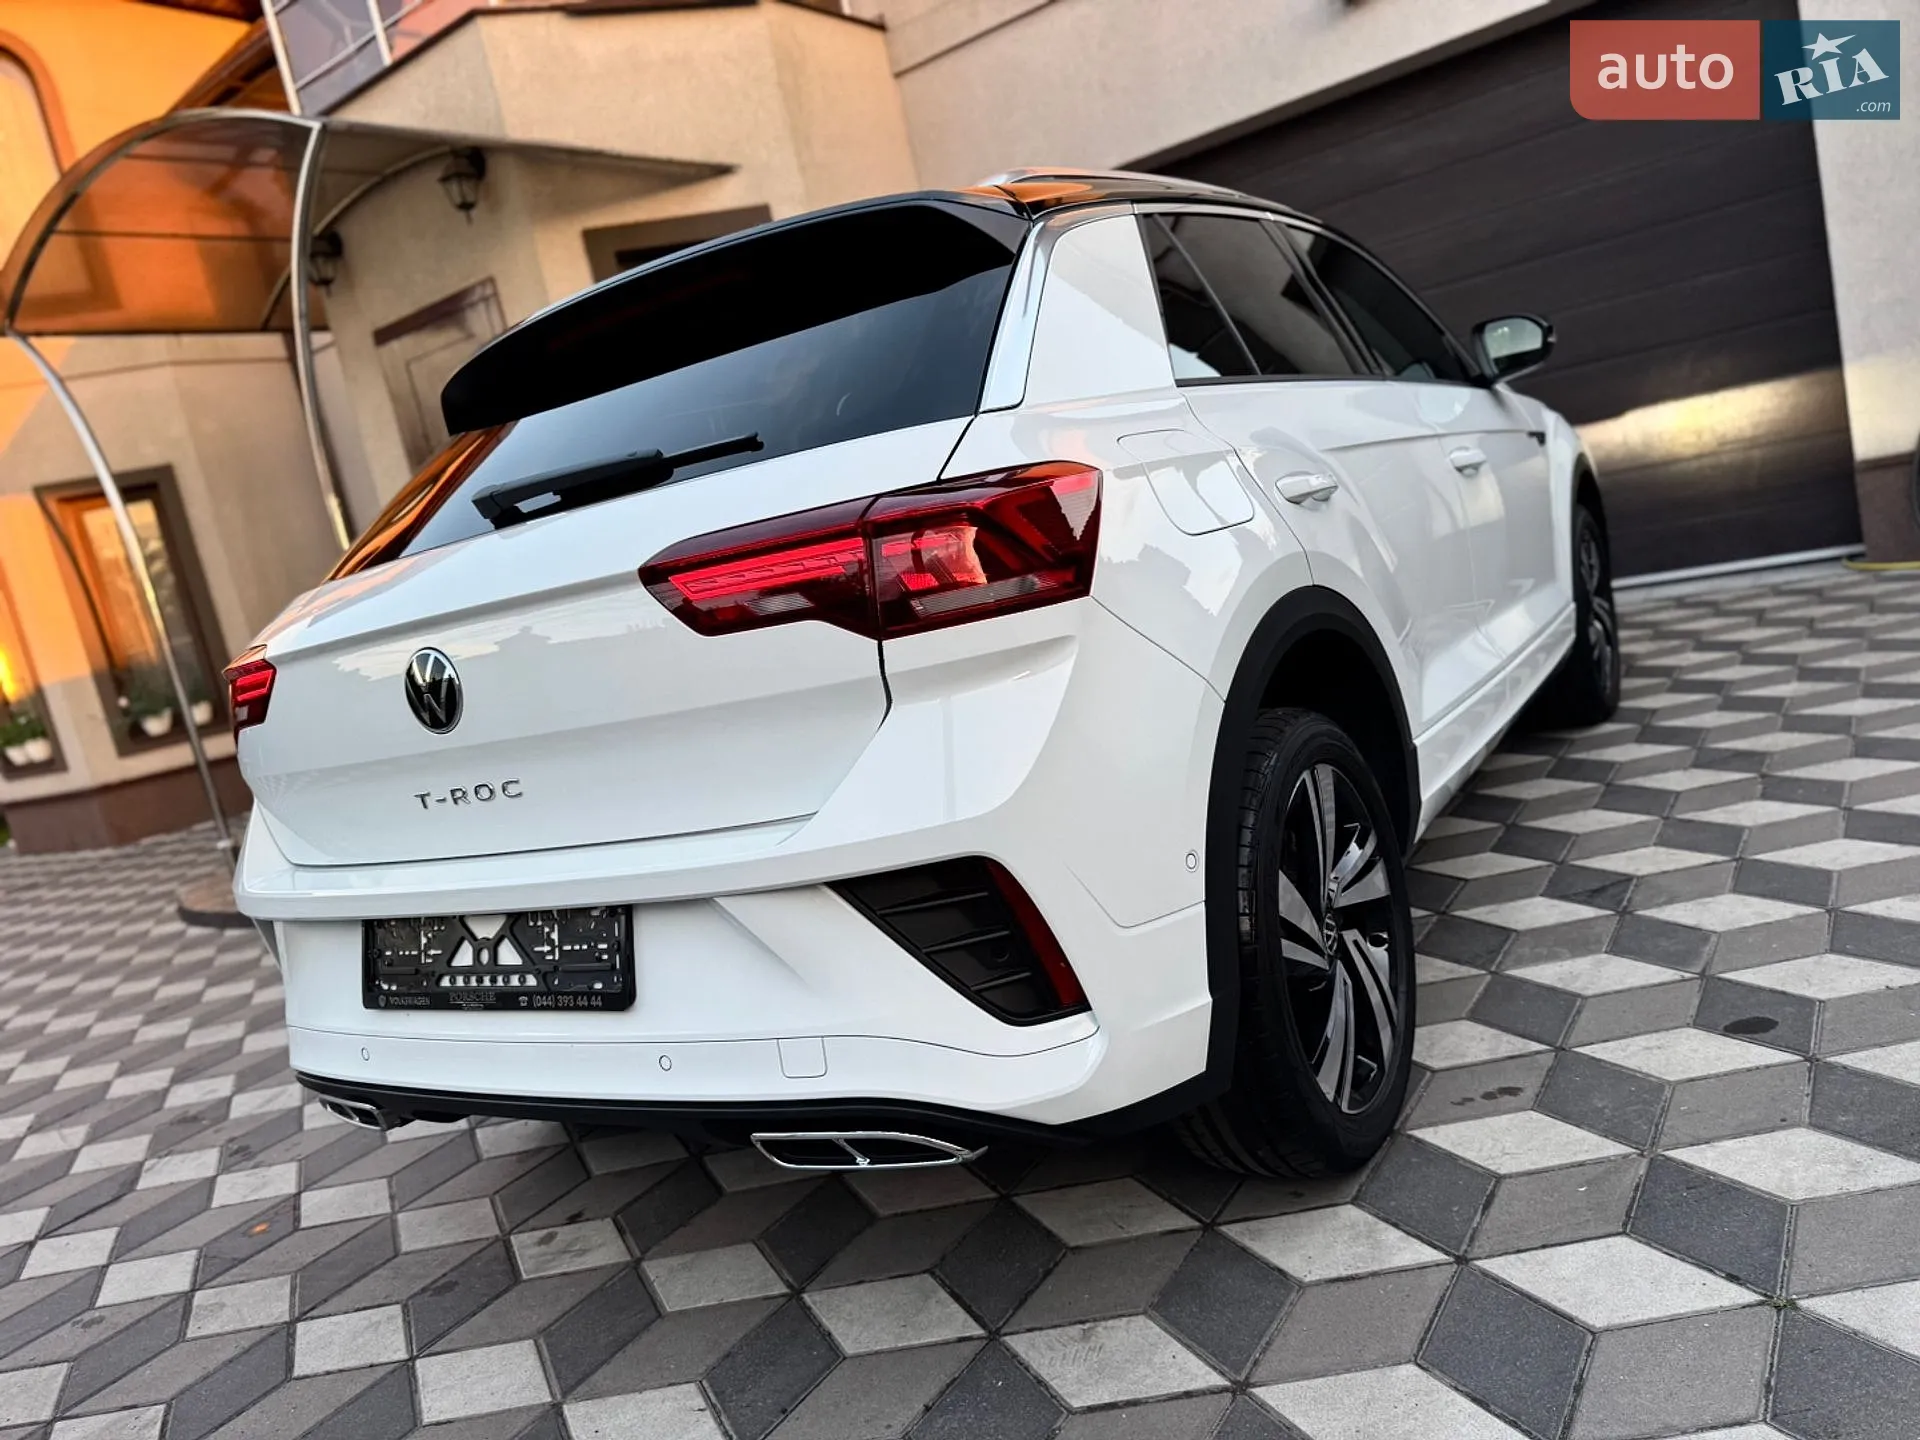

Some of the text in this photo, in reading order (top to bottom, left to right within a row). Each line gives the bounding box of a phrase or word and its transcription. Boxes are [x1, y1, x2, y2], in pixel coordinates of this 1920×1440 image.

[414, 778, 524, 810] T-ROC
[532, 994, 603, 1008] (044) 393 44 44
